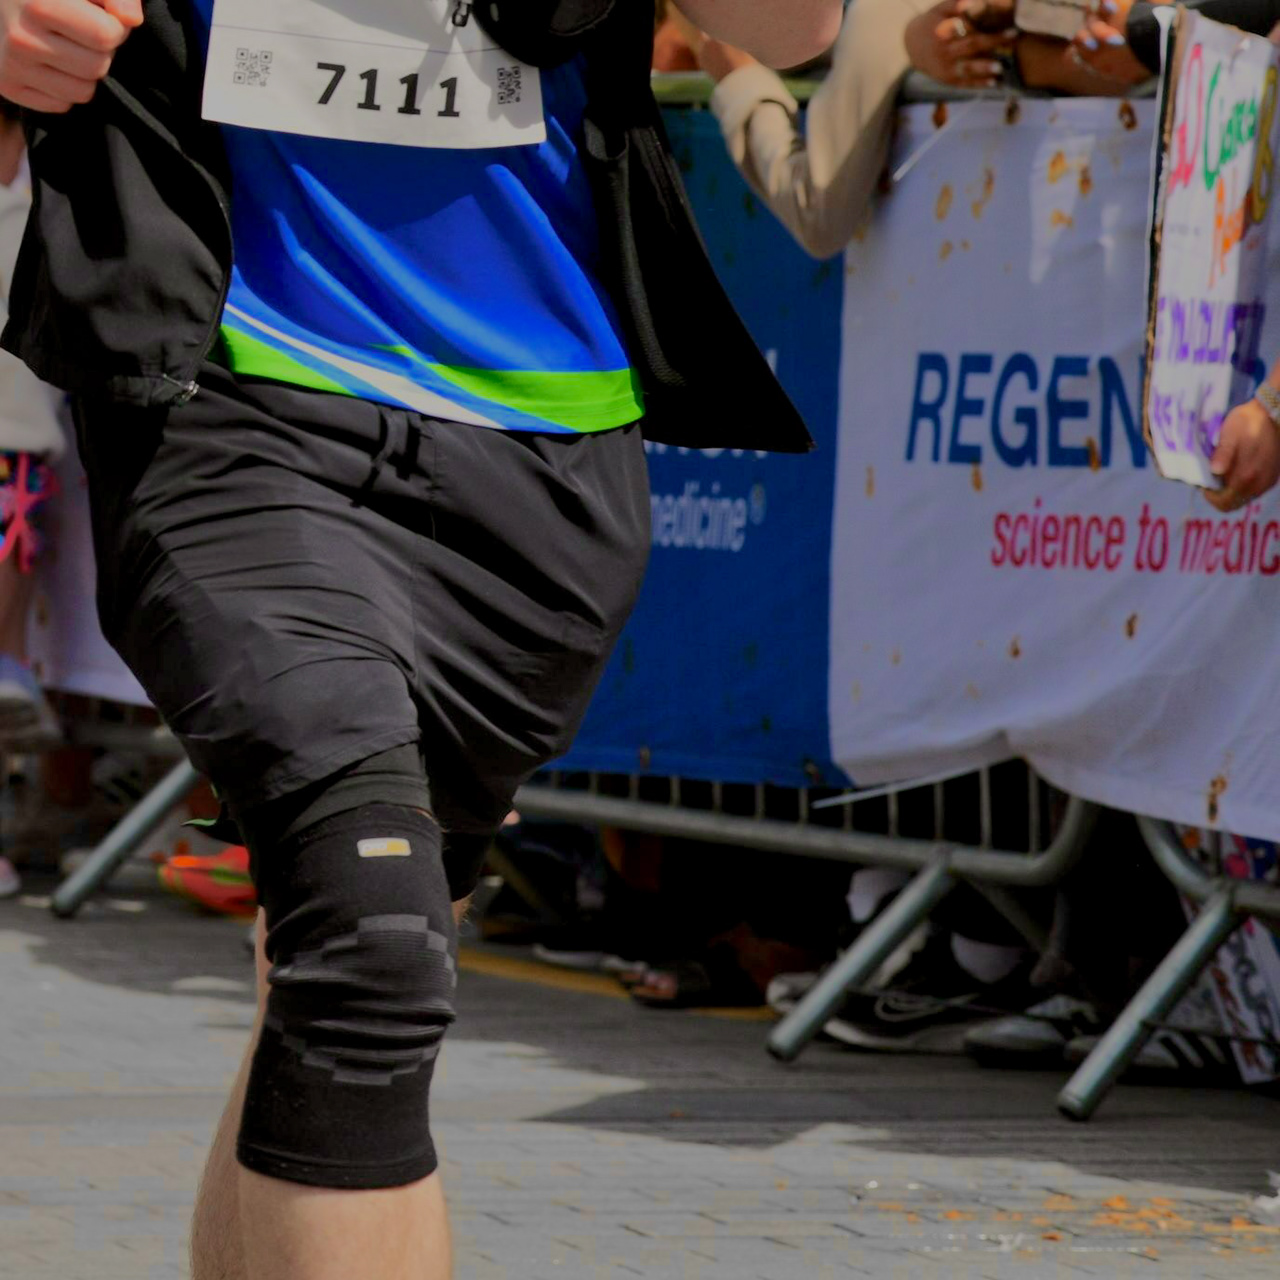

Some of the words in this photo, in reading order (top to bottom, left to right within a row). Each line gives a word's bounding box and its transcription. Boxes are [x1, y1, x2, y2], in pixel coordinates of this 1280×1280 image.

[316, 61, 460, 118] 7111
[991, 497, 1125, 571] science
[1135, 505, 1169, 572] to
